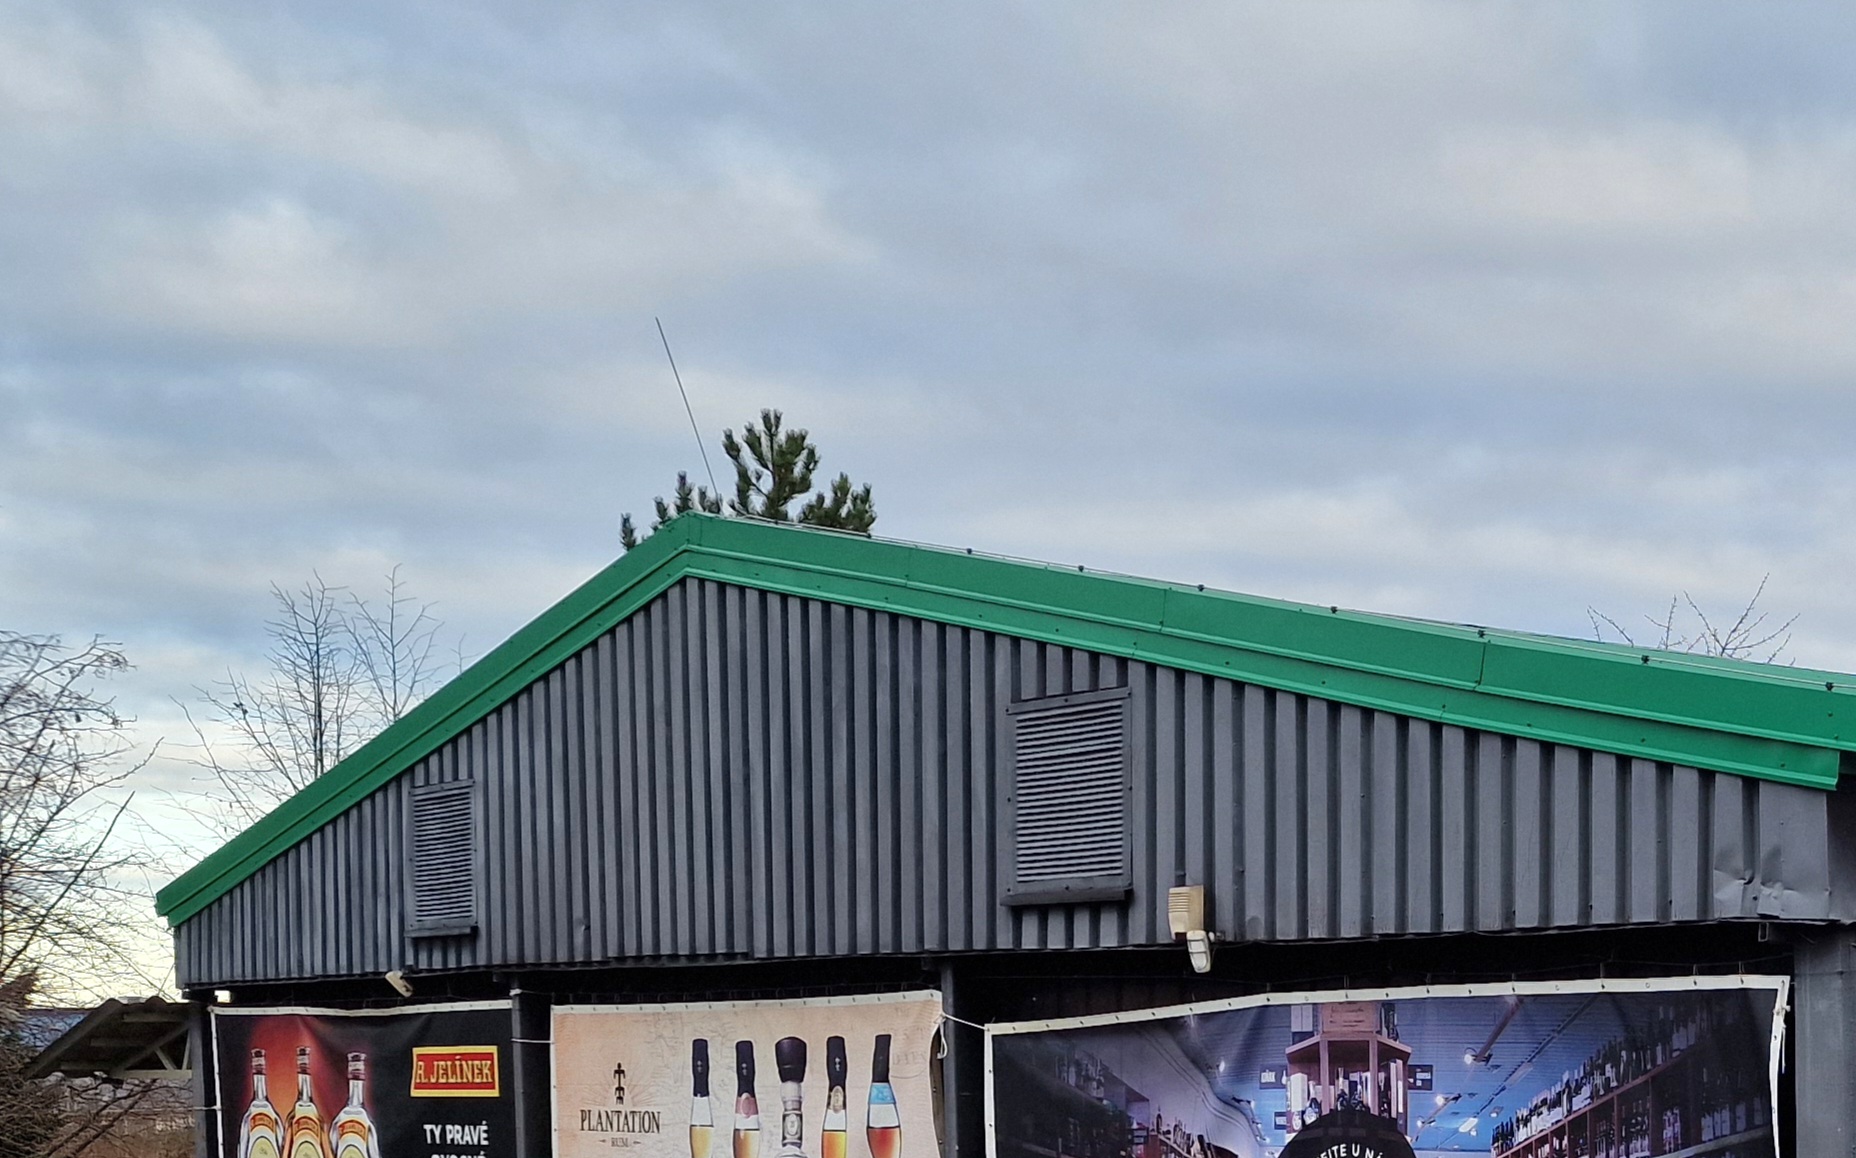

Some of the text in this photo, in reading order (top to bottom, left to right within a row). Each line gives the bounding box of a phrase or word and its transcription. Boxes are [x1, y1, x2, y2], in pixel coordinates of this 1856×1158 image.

[416, 1055, 493, 1083] R. JELÍNEK
[424, 1120, 489, 1146] TY PRAVÉ
[580, 1109, 661, 1134] PLANTATION
[611, 1136, 629, 1148] RUM
[1352, 1142, 1360, 1157] U
